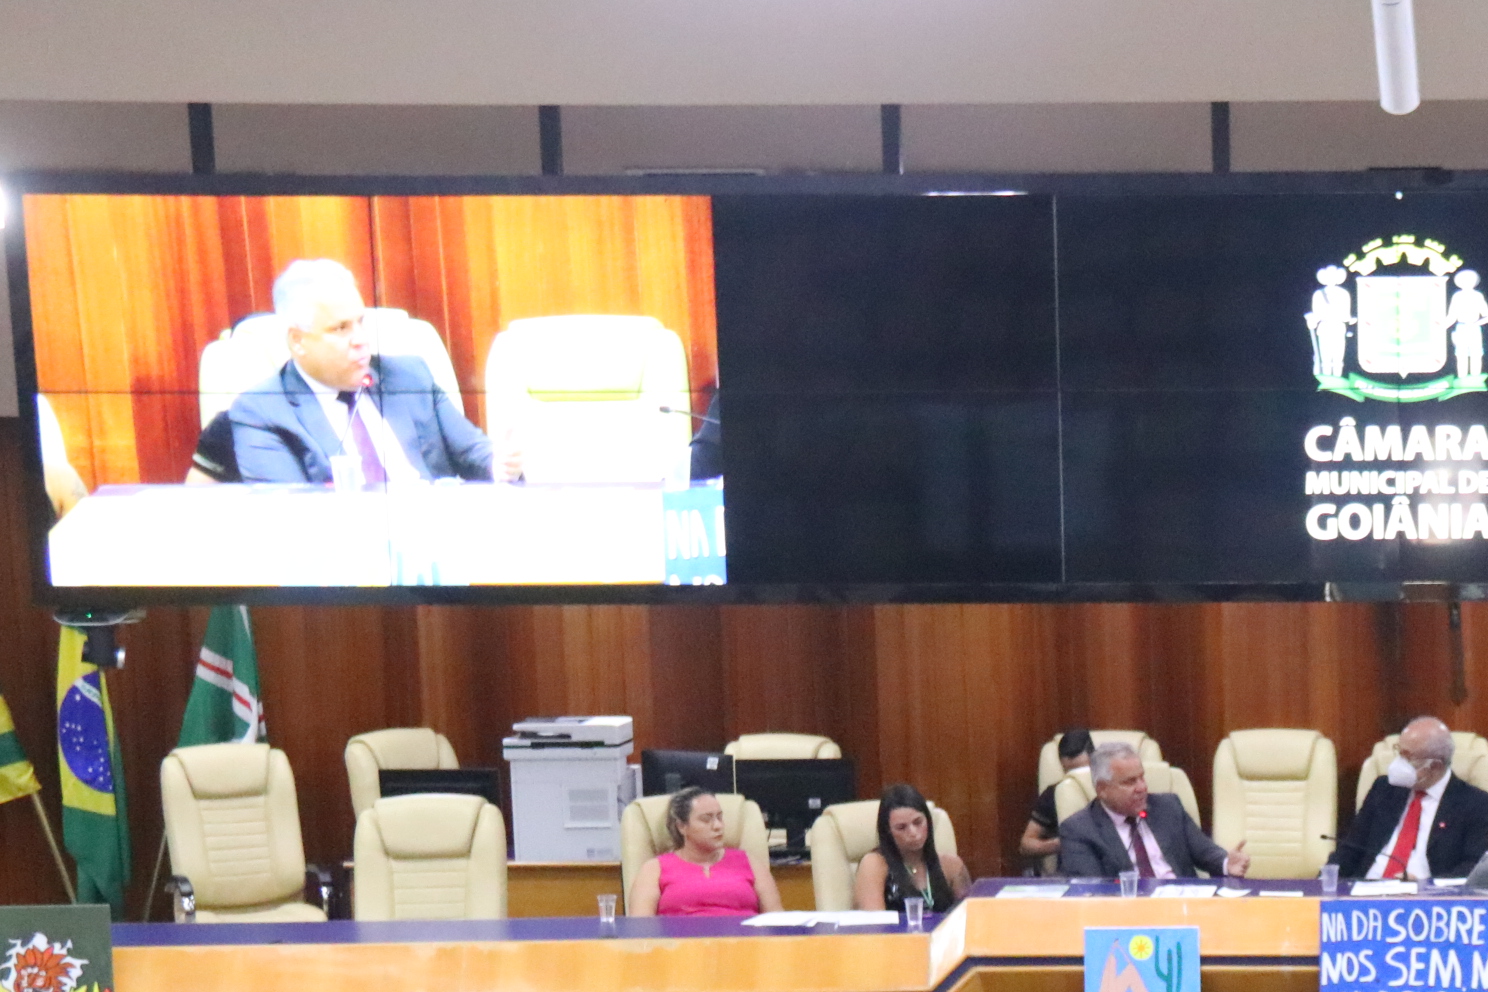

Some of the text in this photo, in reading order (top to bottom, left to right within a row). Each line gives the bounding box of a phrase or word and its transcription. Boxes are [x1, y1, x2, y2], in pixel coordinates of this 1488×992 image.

[1305, 470, 1455, 495] MUNICIPAL
[1385, 905, 1487, 946] SOBRE
[1321, 949, 1377, 986] NOS
